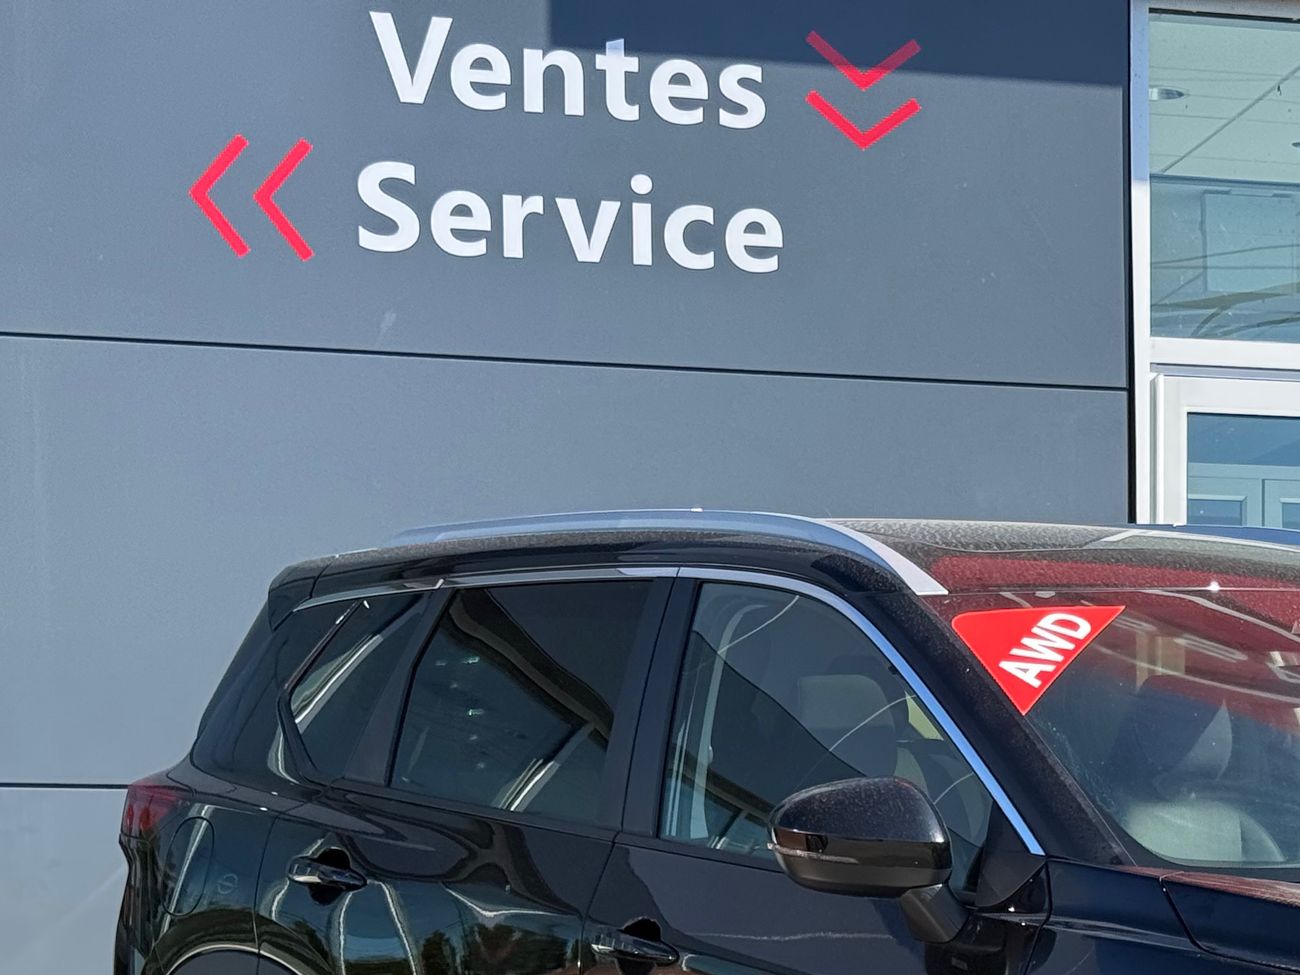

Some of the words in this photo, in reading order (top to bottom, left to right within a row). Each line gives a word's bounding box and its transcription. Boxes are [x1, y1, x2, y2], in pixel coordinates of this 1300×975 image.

[369, 11, 767, 129] Ventes
[356, 161, 784, 272] Service
[999, 612, 1091, 688] AWD
